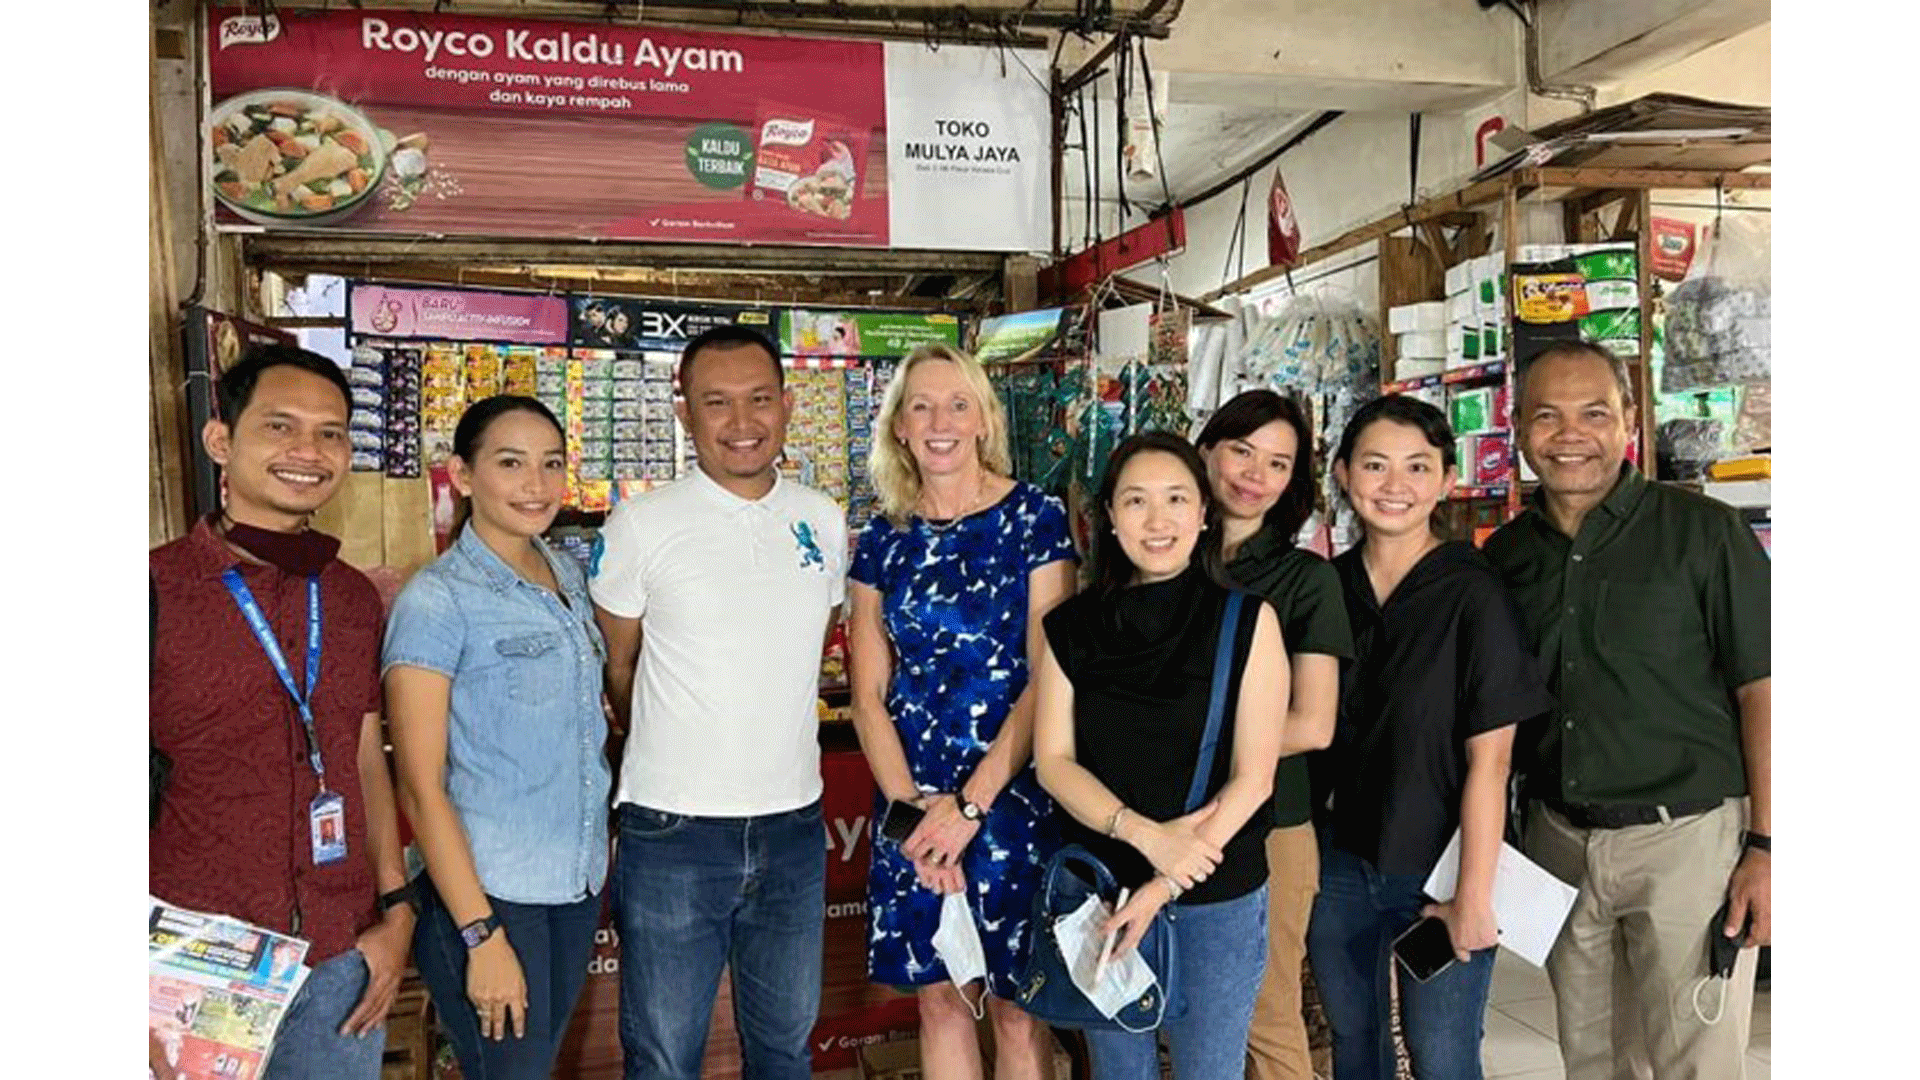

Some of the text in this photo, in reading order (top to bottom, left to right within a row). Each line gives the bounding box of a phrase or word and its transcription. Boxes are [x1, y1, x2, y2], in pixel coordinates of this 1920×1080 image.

[361, 17, 744, 77] Royco Kaldu Ayam
[425, 65, 690, 93] dengan ayam yang direbus lama
[489, 89, 632, 110] dan kaya rempah
[934, 119, 991, 139] TOKO
[701, 138, 741, 156] KALDU
[905, 143, 1021, 163] MULYA JAYA
[698, 157, 746, 176] TERBAIK
[641, 311, 688, 340] 3X
